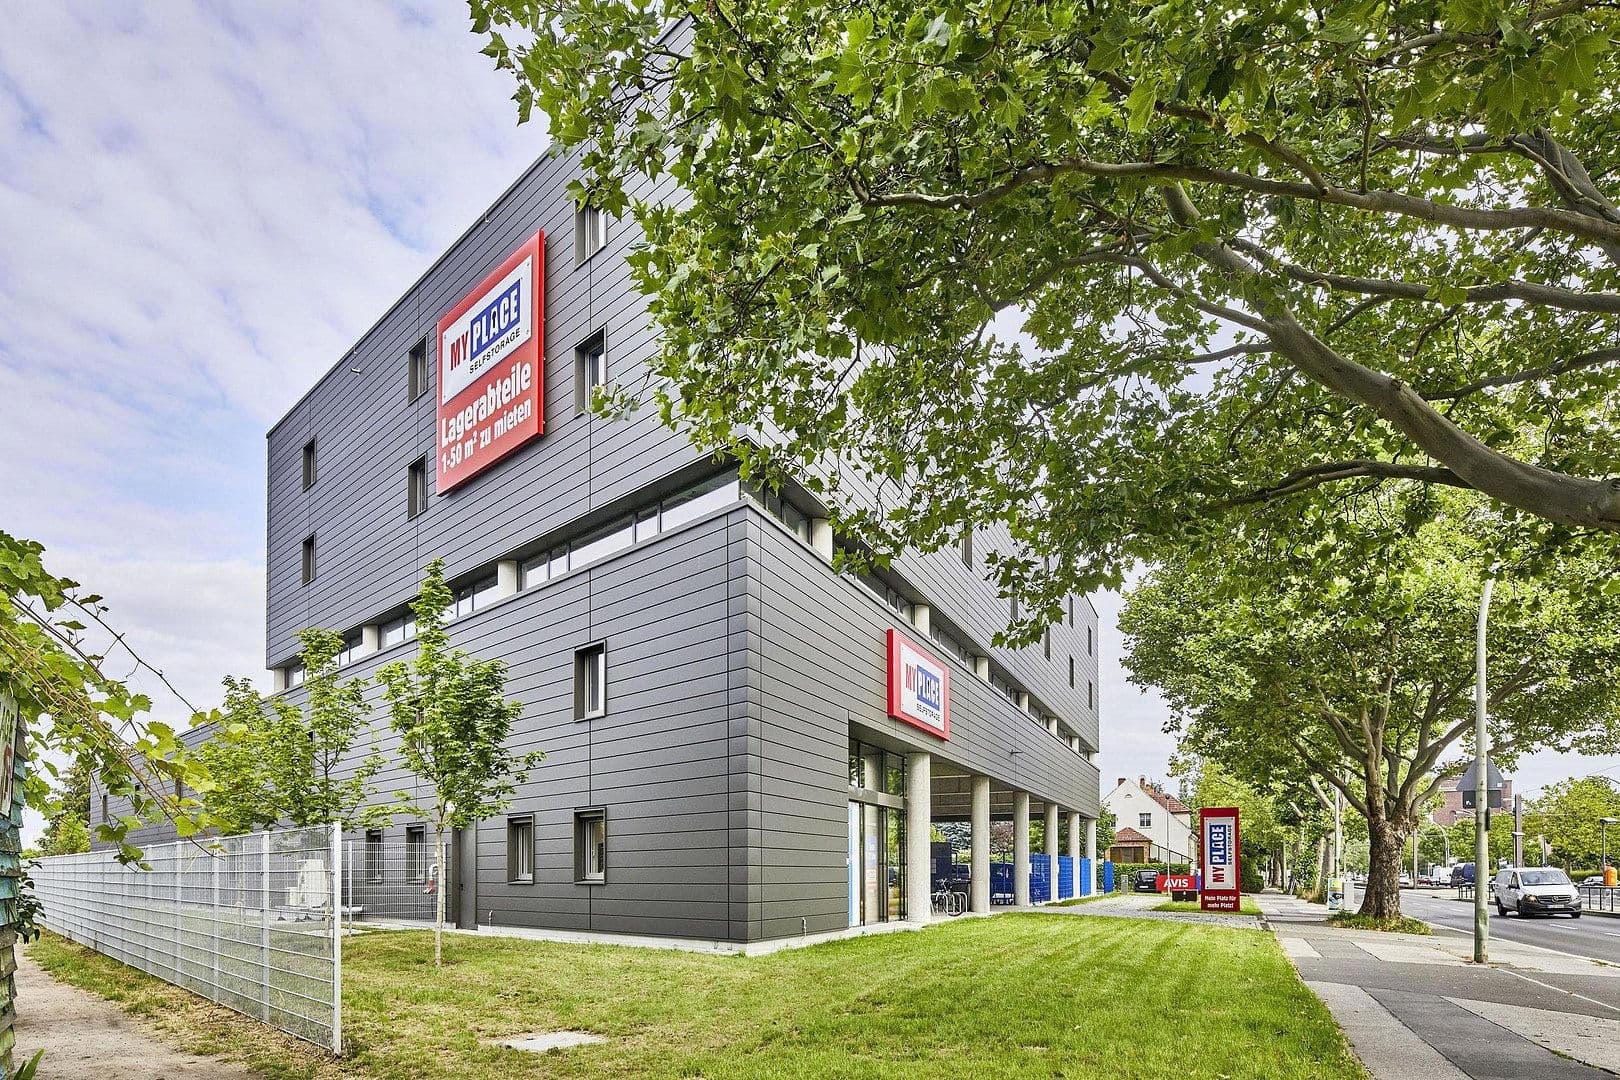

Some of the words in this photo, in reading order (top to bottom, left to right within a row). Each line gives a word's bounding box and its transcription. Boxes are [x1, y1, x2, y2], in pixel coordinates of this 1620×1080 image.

[450, 329, 470, 372] MY
[472, 287, 519, 354] PLACE
[469, 328, 521, 374] SELFSTORAGE
[441, 361, 531, 449] Lagerabteile
[441, 442, 462, 474] 1-50
[464, 430, 479, 460] m²
[480, 427, 491, 447] zu
[493, 398, 532, 437] mieten
[905, 663, 917, 693] MY
[918, 670, 939, 706] PLACE
[1211, 826, 1225, 863] PLACE
[1163, 878, 1189, 888] AVIS
[1212, 866, 1225, 883] MY
